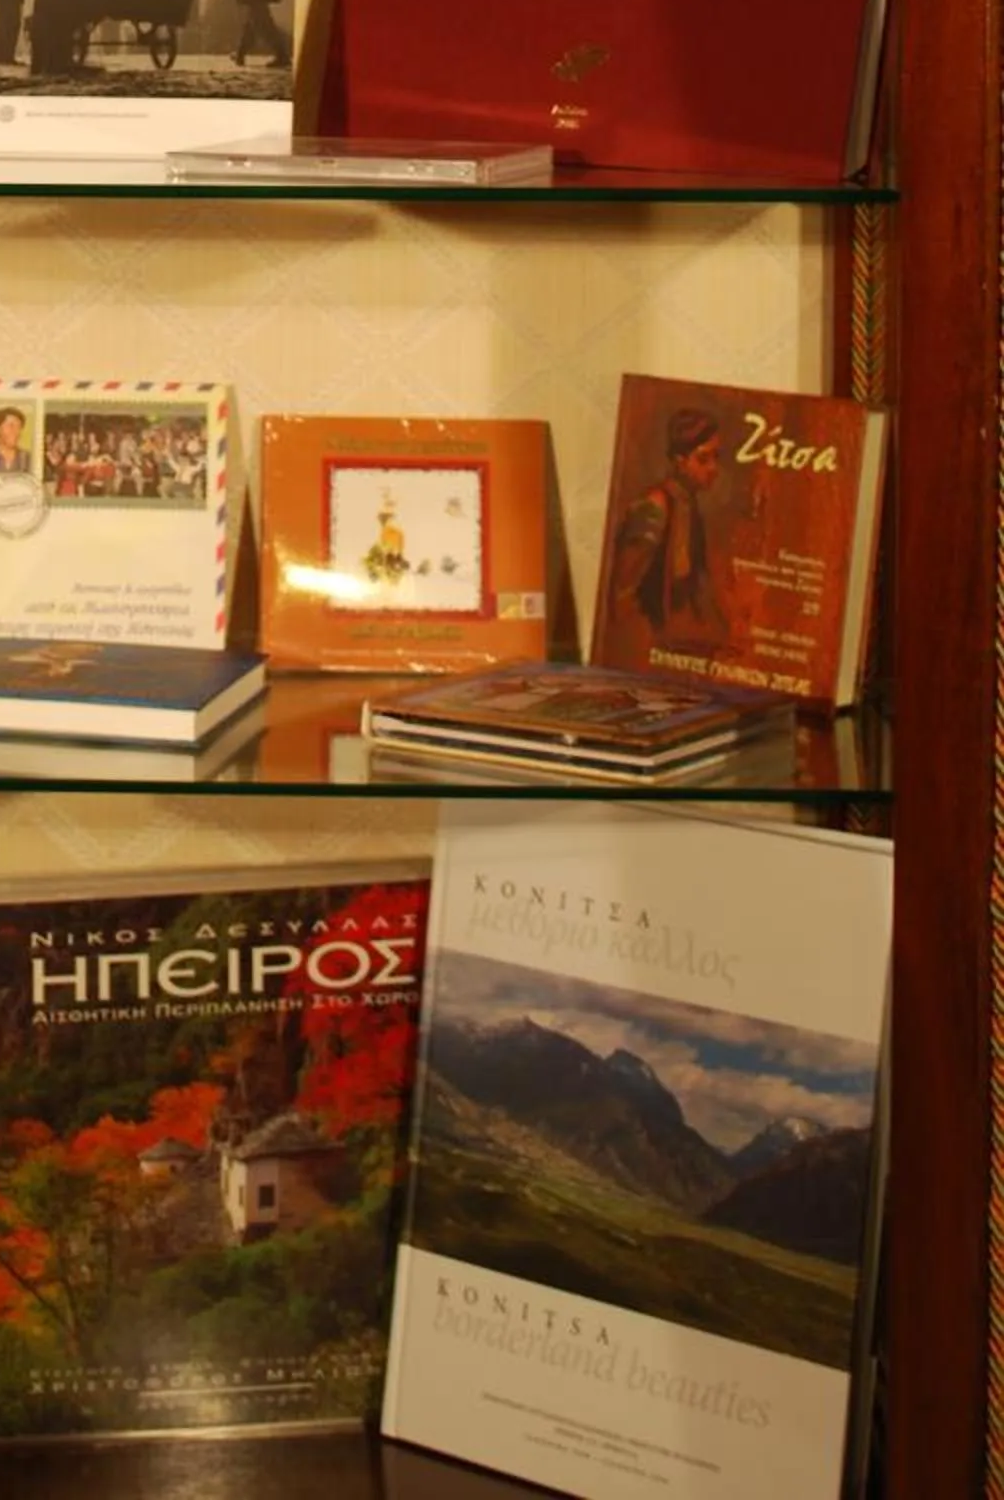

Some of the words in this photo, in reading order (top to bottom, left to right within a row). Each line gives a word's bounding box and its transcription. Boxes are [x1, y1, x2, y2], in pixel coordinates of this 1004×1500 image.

[736, 412, 838, 473] Ζίτσα
[473, 872, 651, 929] ΚΟΝΙΤΣΑ
[30, 928, 164, 948] ΝΙΚΟΣ
[31, 938, 417, 1005] ΗΠΕΙΡΟΣ
[32, 1007, 148, 1026] ΑΙΣΘΗΤΙΚΗ
[436, 1277, 612, 1347] KONITSA
[431, 1301, 618, 1384] borderland
[626, 1345, 773, 1430] beauties
